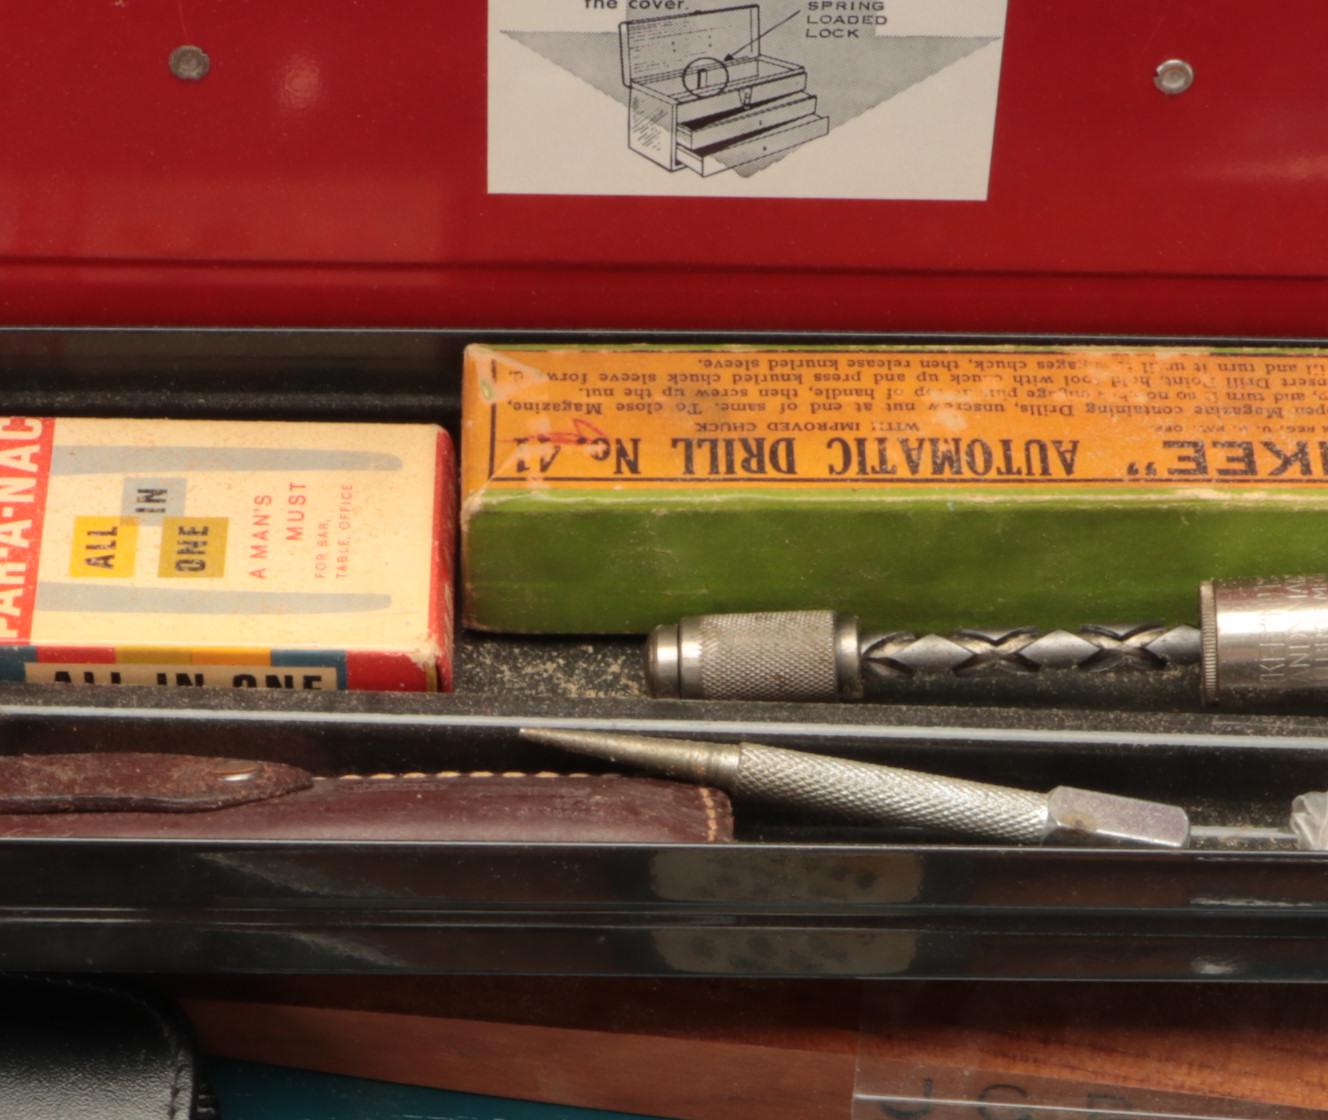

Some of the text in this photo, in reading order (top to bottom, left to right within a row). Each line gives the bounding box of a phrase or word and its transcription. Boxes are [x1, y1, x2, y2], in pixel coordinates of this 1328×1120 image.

[628, 0, 690, 11] cover.
[807, 0, 885, 11] SPRING
[806, 15, 888, 26] LOADED
[805, 28, 860, 39] LOCK
[698, 359, 760, 371] sleeve.
[768, 360, 838, 371] knurled
[847, 360, 911, 371] release
[920, 360, 959, 371] then
[969, 359, 1027, 372] chuck,
[1194, 362, 1208, 374] it
[1218, 363, 1255, 373] turn
[1265, 363, 1297, 375] and
[599, 372, 657, 384] sleeve
[668, 373, 721, 385] chuck
[732, 373, 803, 385] knurled
[814, 371, 861, 382] press
[873, 373, 905, 385] and
[916, 372, 939, 382] up
[950, 374, 1003, 385] cuck
[1013, 375, 1053, 387] with
[1226, 377, 1271, 390] Drill
[578, 388, 615, 398] nut.
[624, 388, 653, 400] the
[662, 386, 685, 397] up
[695, 388, 748, 398] screw
[759, 388, 798, 400] then
[809, 387, 875, 400] handle,
[1227, 392, 1264, 402] turn
[1274, 392, 1305, 404] and
[507, 401, 603, 415] Magazine,
[616, 402, 663, 415] close
[676, 402, 702, 415] To
[715, 403, 766, 413] same.
[779, 403, 798, 415] of
[810, 403, 842, 415] end
[856, 403, 873, 413] at
[885, 403, 915, 413] nut
[928, 403, 1005, 413] unscrew
[1014, 402, 1073, 417] Drills,
[1085, 402, 1183, 417] containing
[1194, 403, 1283, 419] Magazine
[695, 421, 757, 433] CHUCK
[767, 421, 860, 432] IMPROVED
[1280, 425, 1315, 434] REG.
[671, 437, 799, 476] DRILL
[828, 437, 1081, 477] AUTOMATIC
[135, 487, 169, 514] IN
[285, 481, 307, 541] MUST
[248, 495, 272, 580] A MAN'S
[335, 484, 353, 579] TABLE, OFFICE
[85, 523, 210, 573] ALL ONE
[314, 519, 331, 579] FOR BAR,
